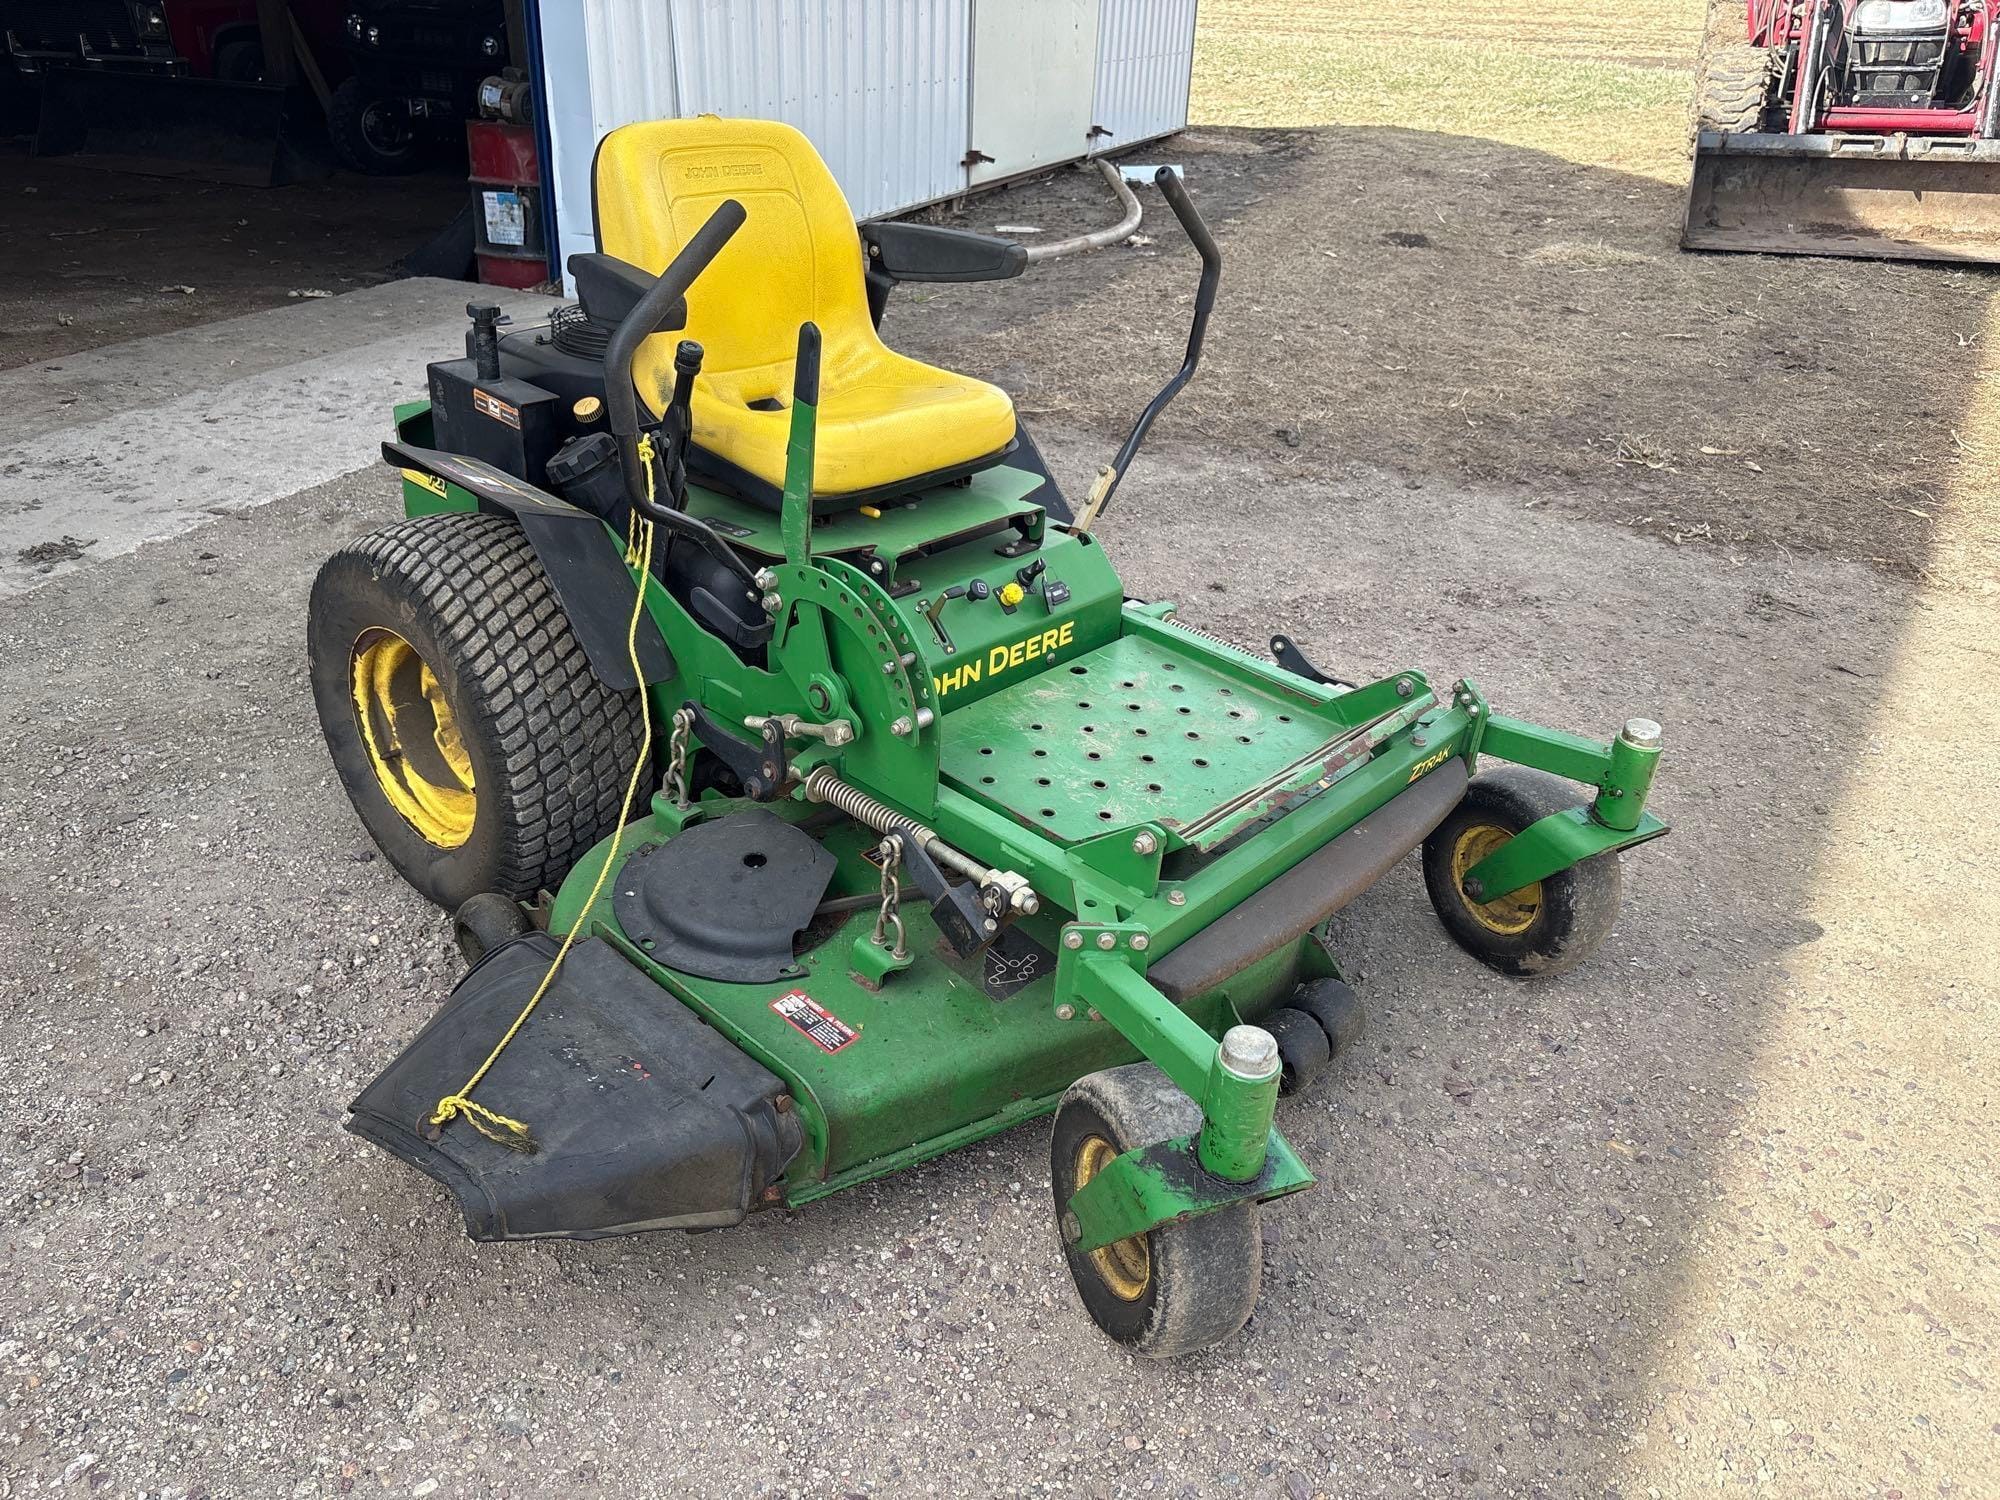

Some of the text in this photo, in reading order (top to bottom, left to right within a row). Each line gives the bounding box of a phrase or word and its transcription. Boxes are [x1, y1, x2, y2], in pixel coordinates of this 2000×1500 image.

[684, 163, 763, 180] JOHN DEERE
[988, 620, 1075, 677] DEERE
